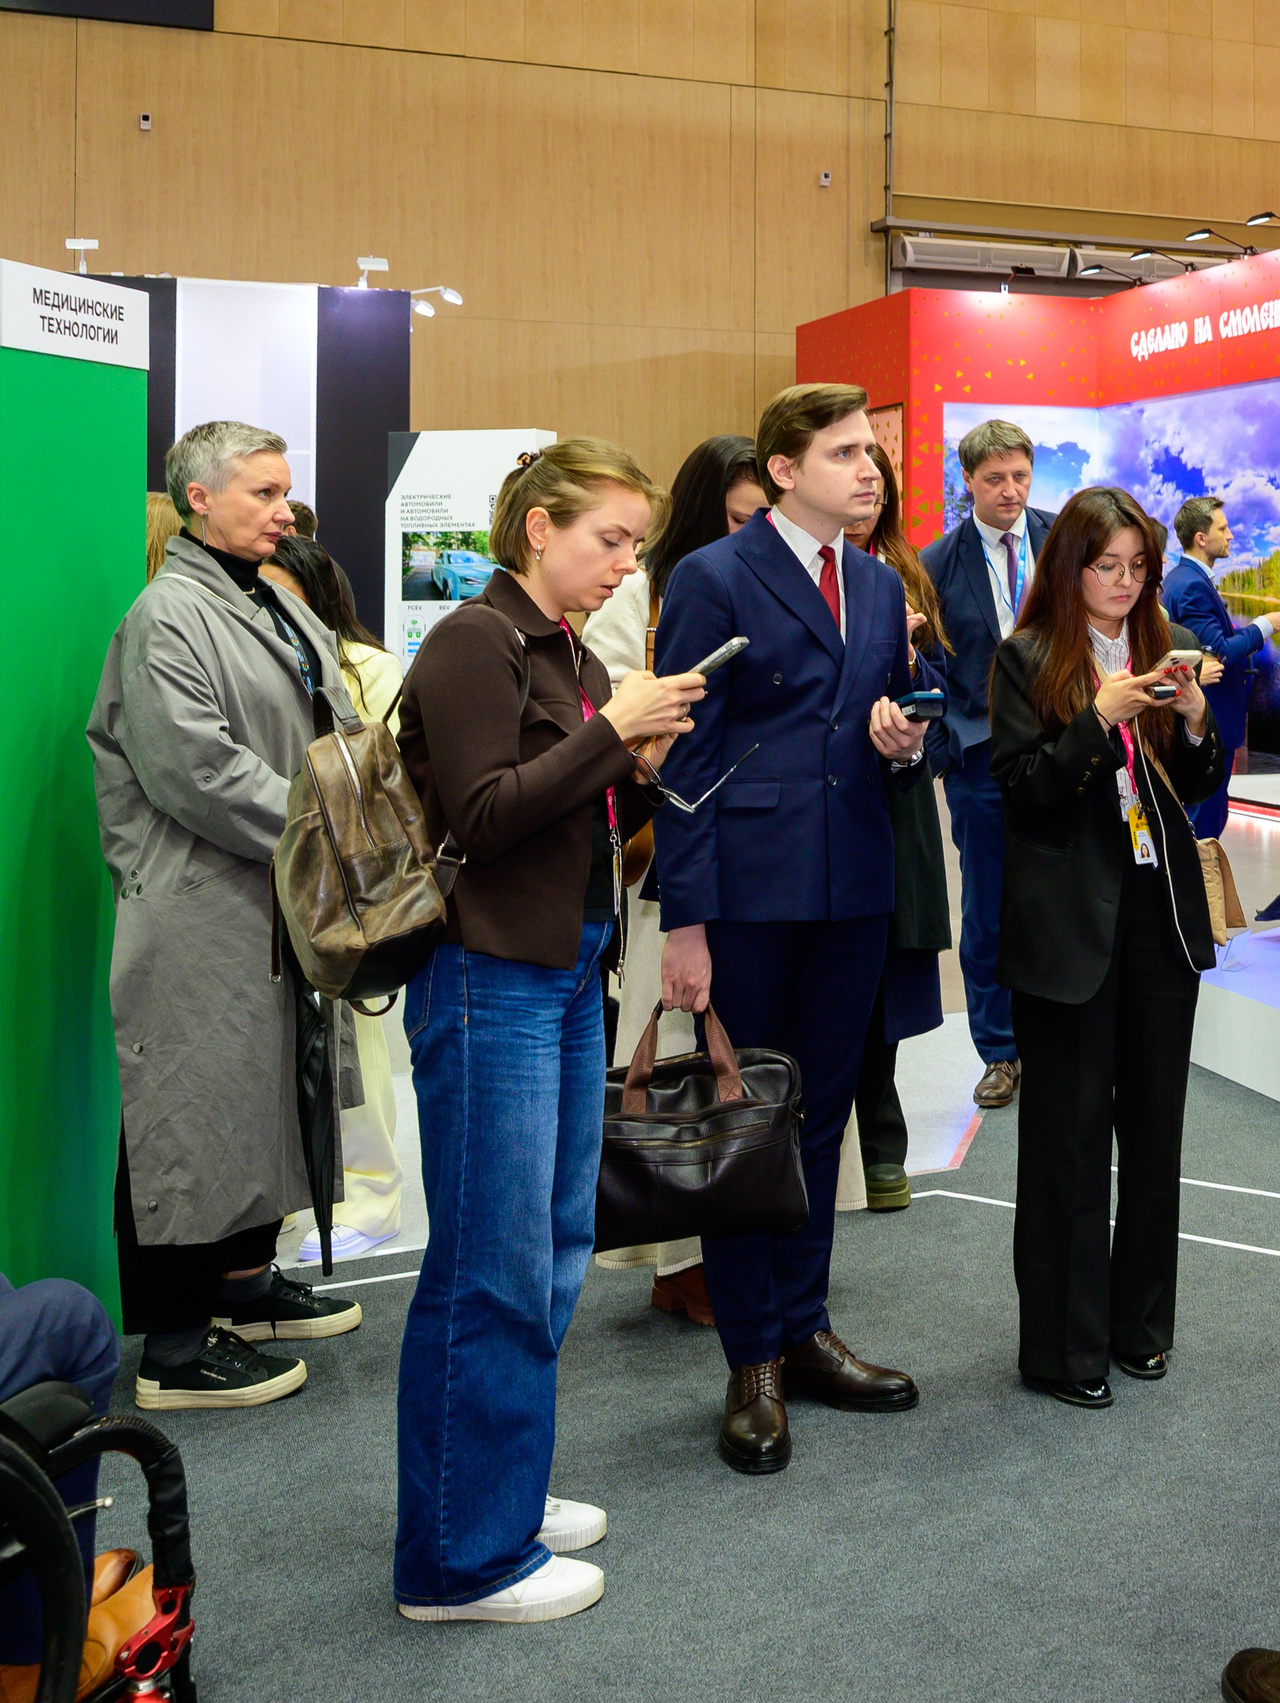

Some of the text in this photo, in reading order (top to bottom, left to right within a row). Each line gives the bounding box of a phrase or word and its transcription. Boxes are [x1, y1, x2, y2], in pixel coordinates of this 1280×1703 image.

[32, 287, 125, 322] МЕДИЦИНСКИЕ
[39, 315, 119, 345] ТЕХНОЛОГИИ
[1130, 320, 1188, 362] СДЕЛАНО
[1194, 315, 1213, 345] НА
